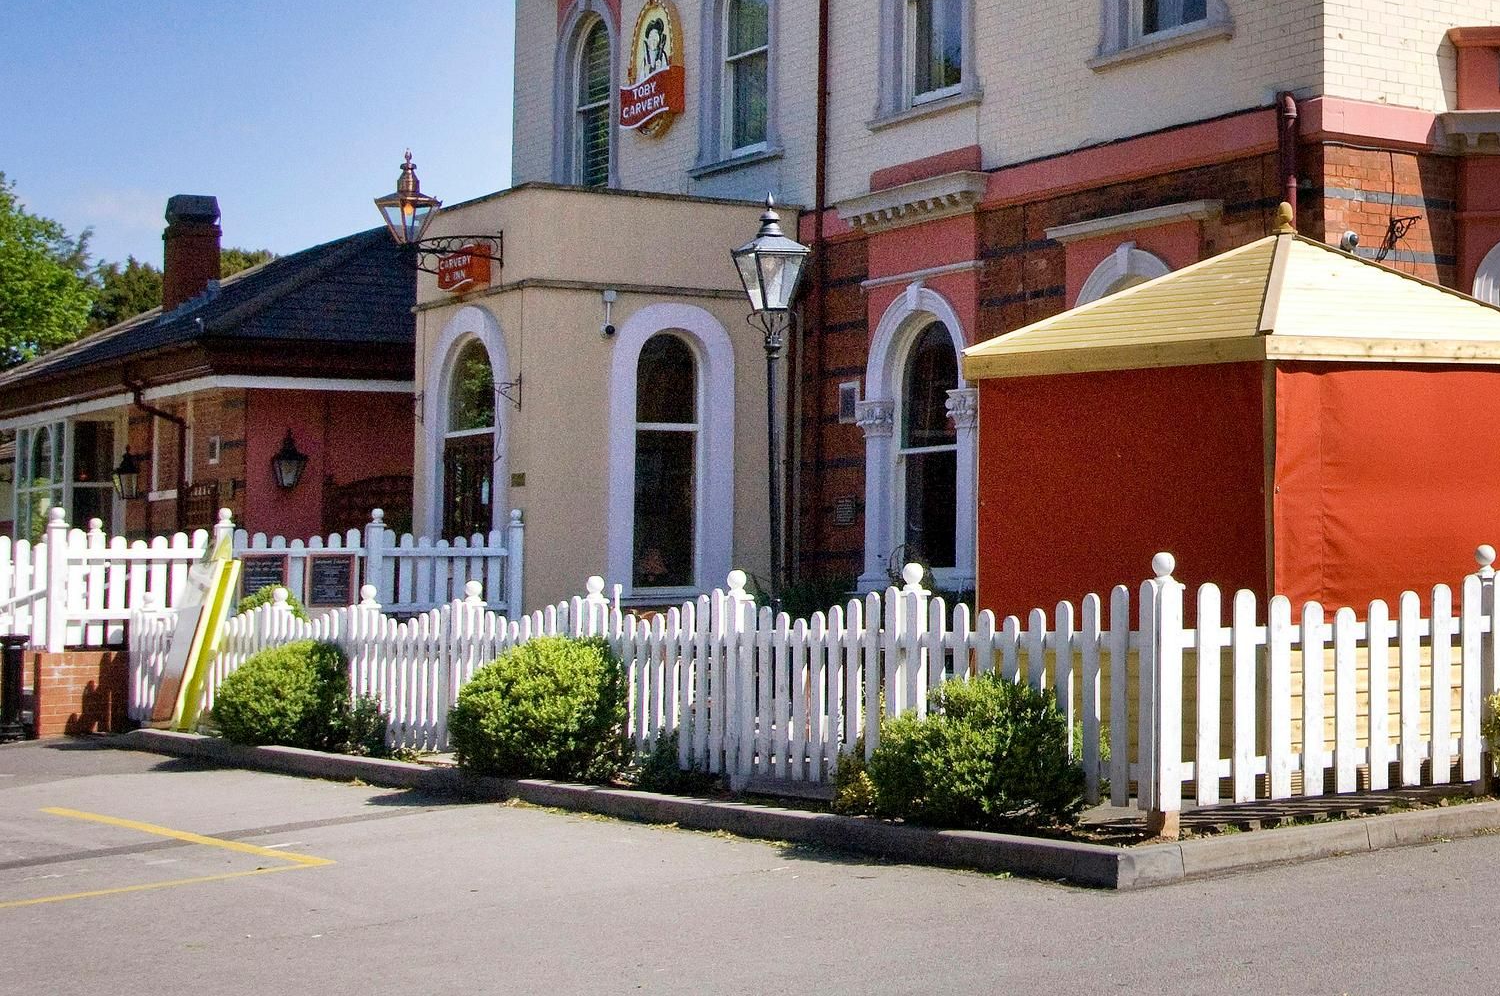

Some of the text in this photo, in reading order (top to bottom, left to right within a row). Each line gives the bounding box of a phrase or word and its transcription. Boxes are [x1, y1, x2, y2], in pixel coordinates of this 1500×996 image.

[632, 81, 657, 100] TOBY
[622, 93, 666, 119] CARVERY
[439, 254, 472, 270] CARVERY
